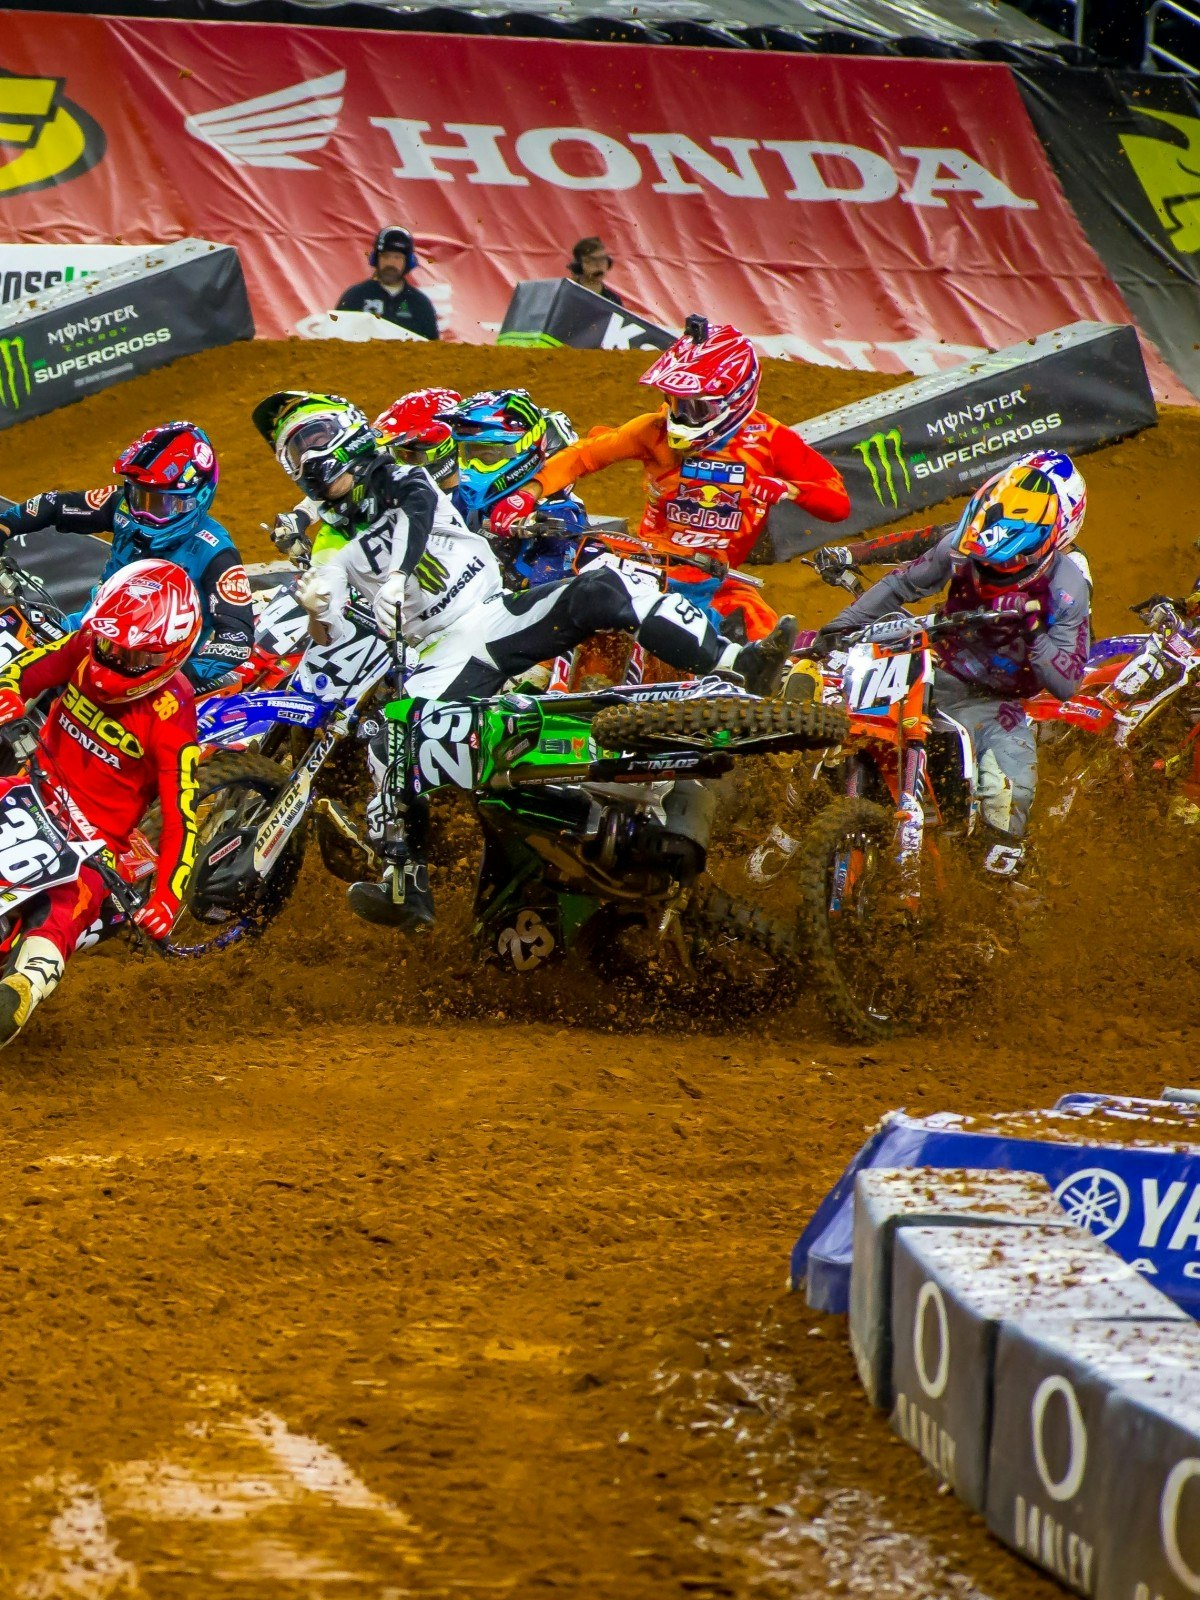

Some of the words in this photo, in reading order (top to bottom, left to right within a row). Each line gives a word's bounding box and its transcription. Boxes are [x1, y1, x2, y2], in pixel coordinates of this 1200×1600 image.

[369, 117, 1039, 209] HONDA
[47, 304, 139, 346] MONSTER
[34, 328, 171, 384] SUPERCROSS
[926, 389, 1027, 438] MONSTER
[684, 458, 745, 473] GoPro
[913, 412, 1062, 479] SUPERCROSS
[667, 503, 700, 527] Red
[701, 509, 743, 531] Bull
[418, 556, 486, 622] Kawasaki
[153, 691, 180, 721] 36
[58, 712, 122, 770] HONDA
[419, 699, 473, 789] 29
[254, 783, 300, 851] DUNLOP
